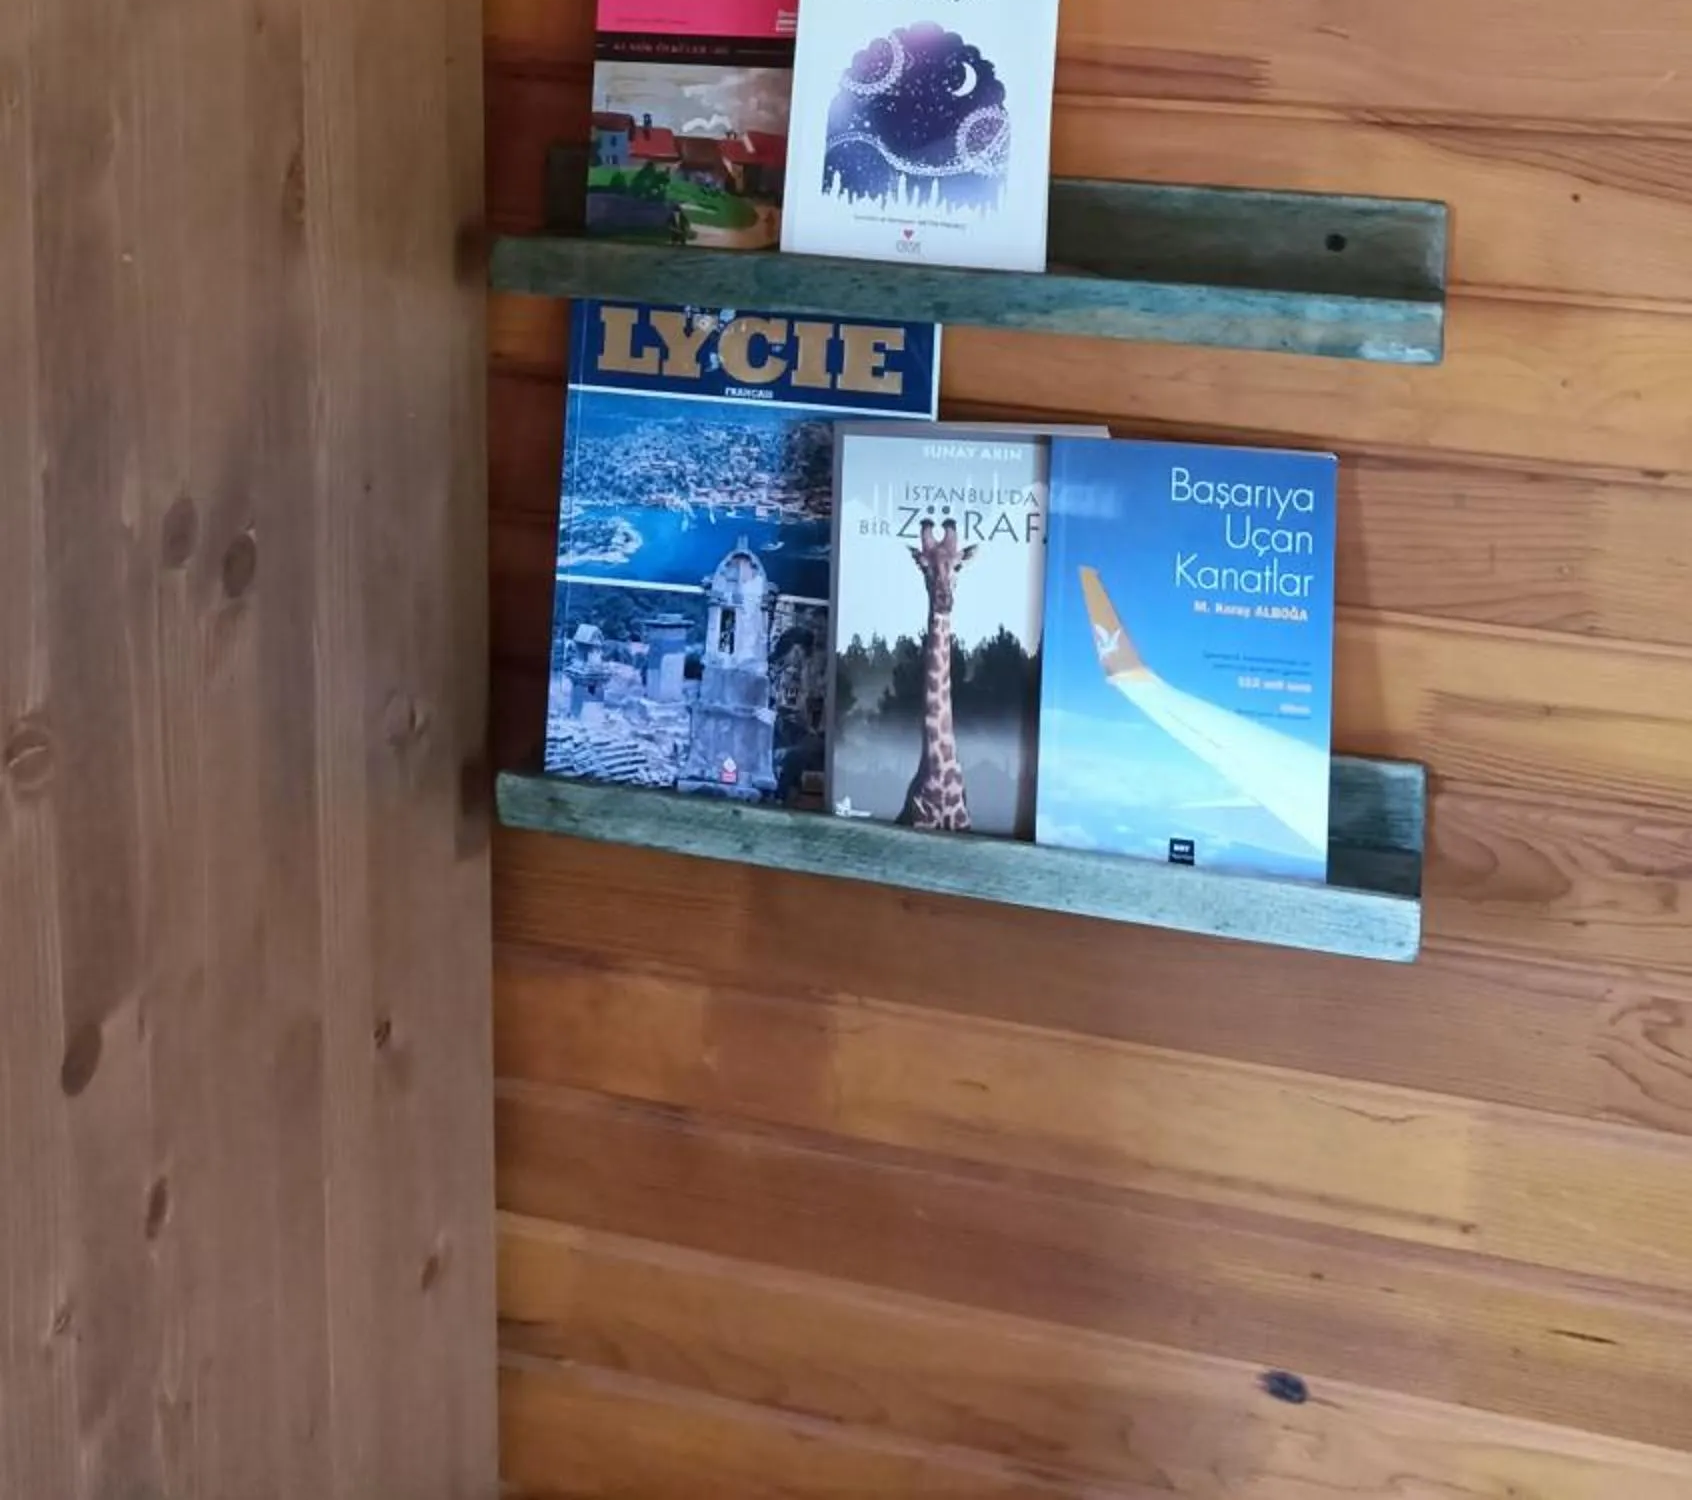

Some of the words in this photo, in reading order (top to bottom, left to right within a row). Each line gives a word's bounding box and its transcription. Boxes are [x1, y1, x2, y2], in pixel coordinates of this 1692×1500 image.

[597, 305, 905, 394] LYCIE
[1170, 467, 1314, 520] Başarıya
[896, 505, 1048, 545] ZÜRAF
[1226, 513, 1313, 557] Uçan
[1175, 551, 1314, 597] Kanatlar
